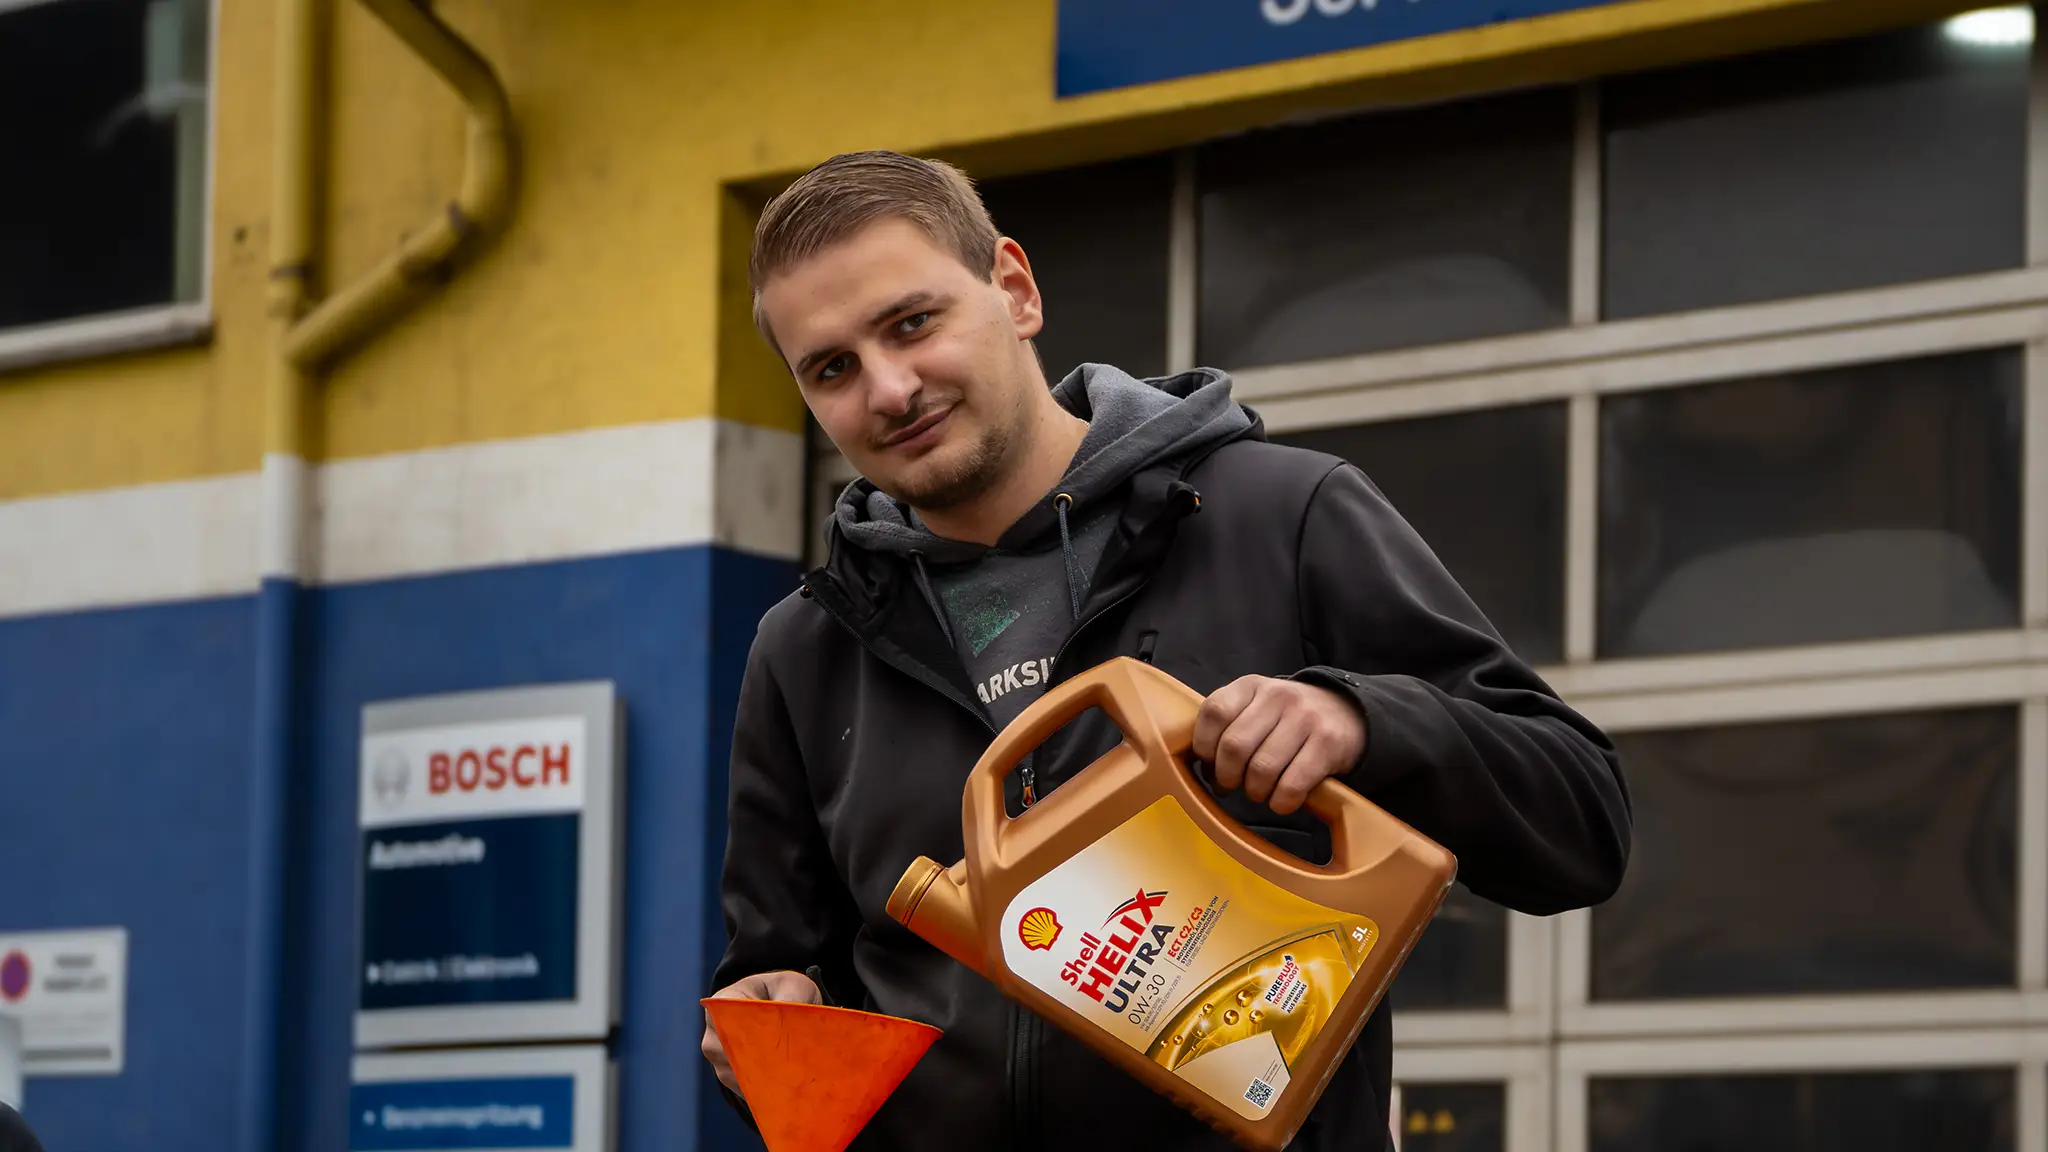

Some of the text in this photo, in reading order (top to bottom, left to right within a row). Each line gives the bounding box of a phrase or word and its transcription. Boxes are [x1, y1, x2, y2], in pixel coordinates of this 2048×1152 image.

[977, 656, 1055, 704] ARKSI
[428, 743, 570, 795] BOSCH
[370, 833, 484, 869] Automotive
[1209, 896, 1219, 907] VON
[1077, 888, 1166, 1002] HELIX
[1167, 938, 1183, 957] ECT
[1352, 926, 1368, 941] 5L
[1060, 931, 1101, 986] Shell
[1104, 923, 1174, 1012] ULTRA
[1128, 974, 1165, 1024] 0W-30
[1265, 960, 1294, 1001] PUREPLUS
[1272, 965, 1300, 1005] TECHNOLOGY
[1280, 980, 1301, 1010] HERGESTELLT
[1286, 983, 1307, 1013] AUS ERDGAS
